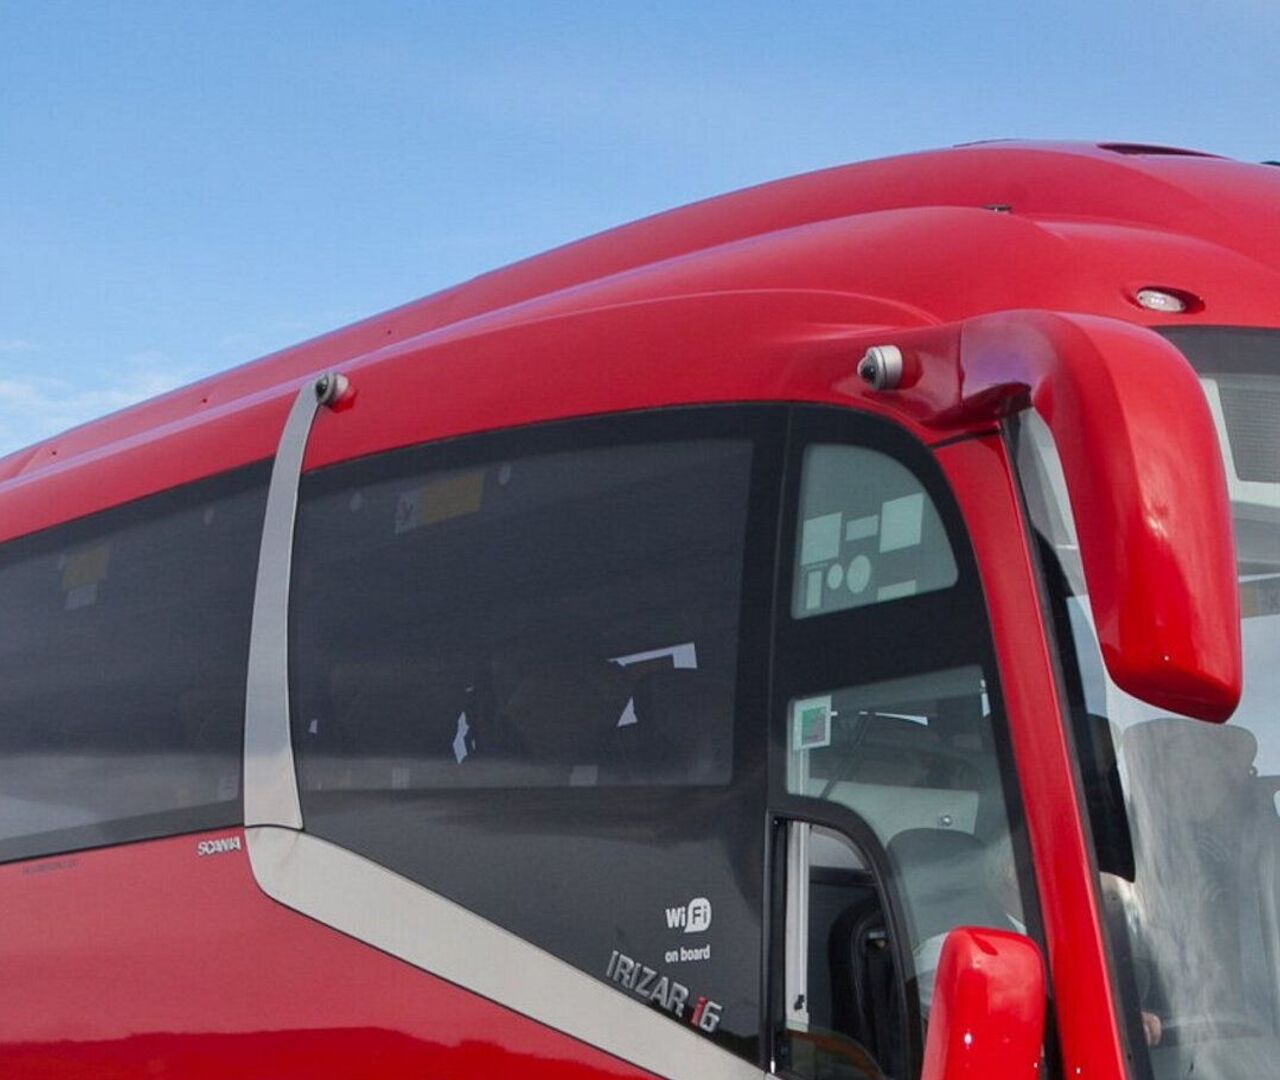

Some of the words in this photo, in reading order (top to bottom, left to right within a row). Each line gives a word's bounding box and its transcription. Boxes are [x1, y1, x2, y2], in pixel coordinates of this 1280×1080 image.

[665, 948, 679, 963] on
[680, 944, 711, 962] board
[605, 949, 690, 1019] IRIZAR
[690, 996, 723, 1034] i6
